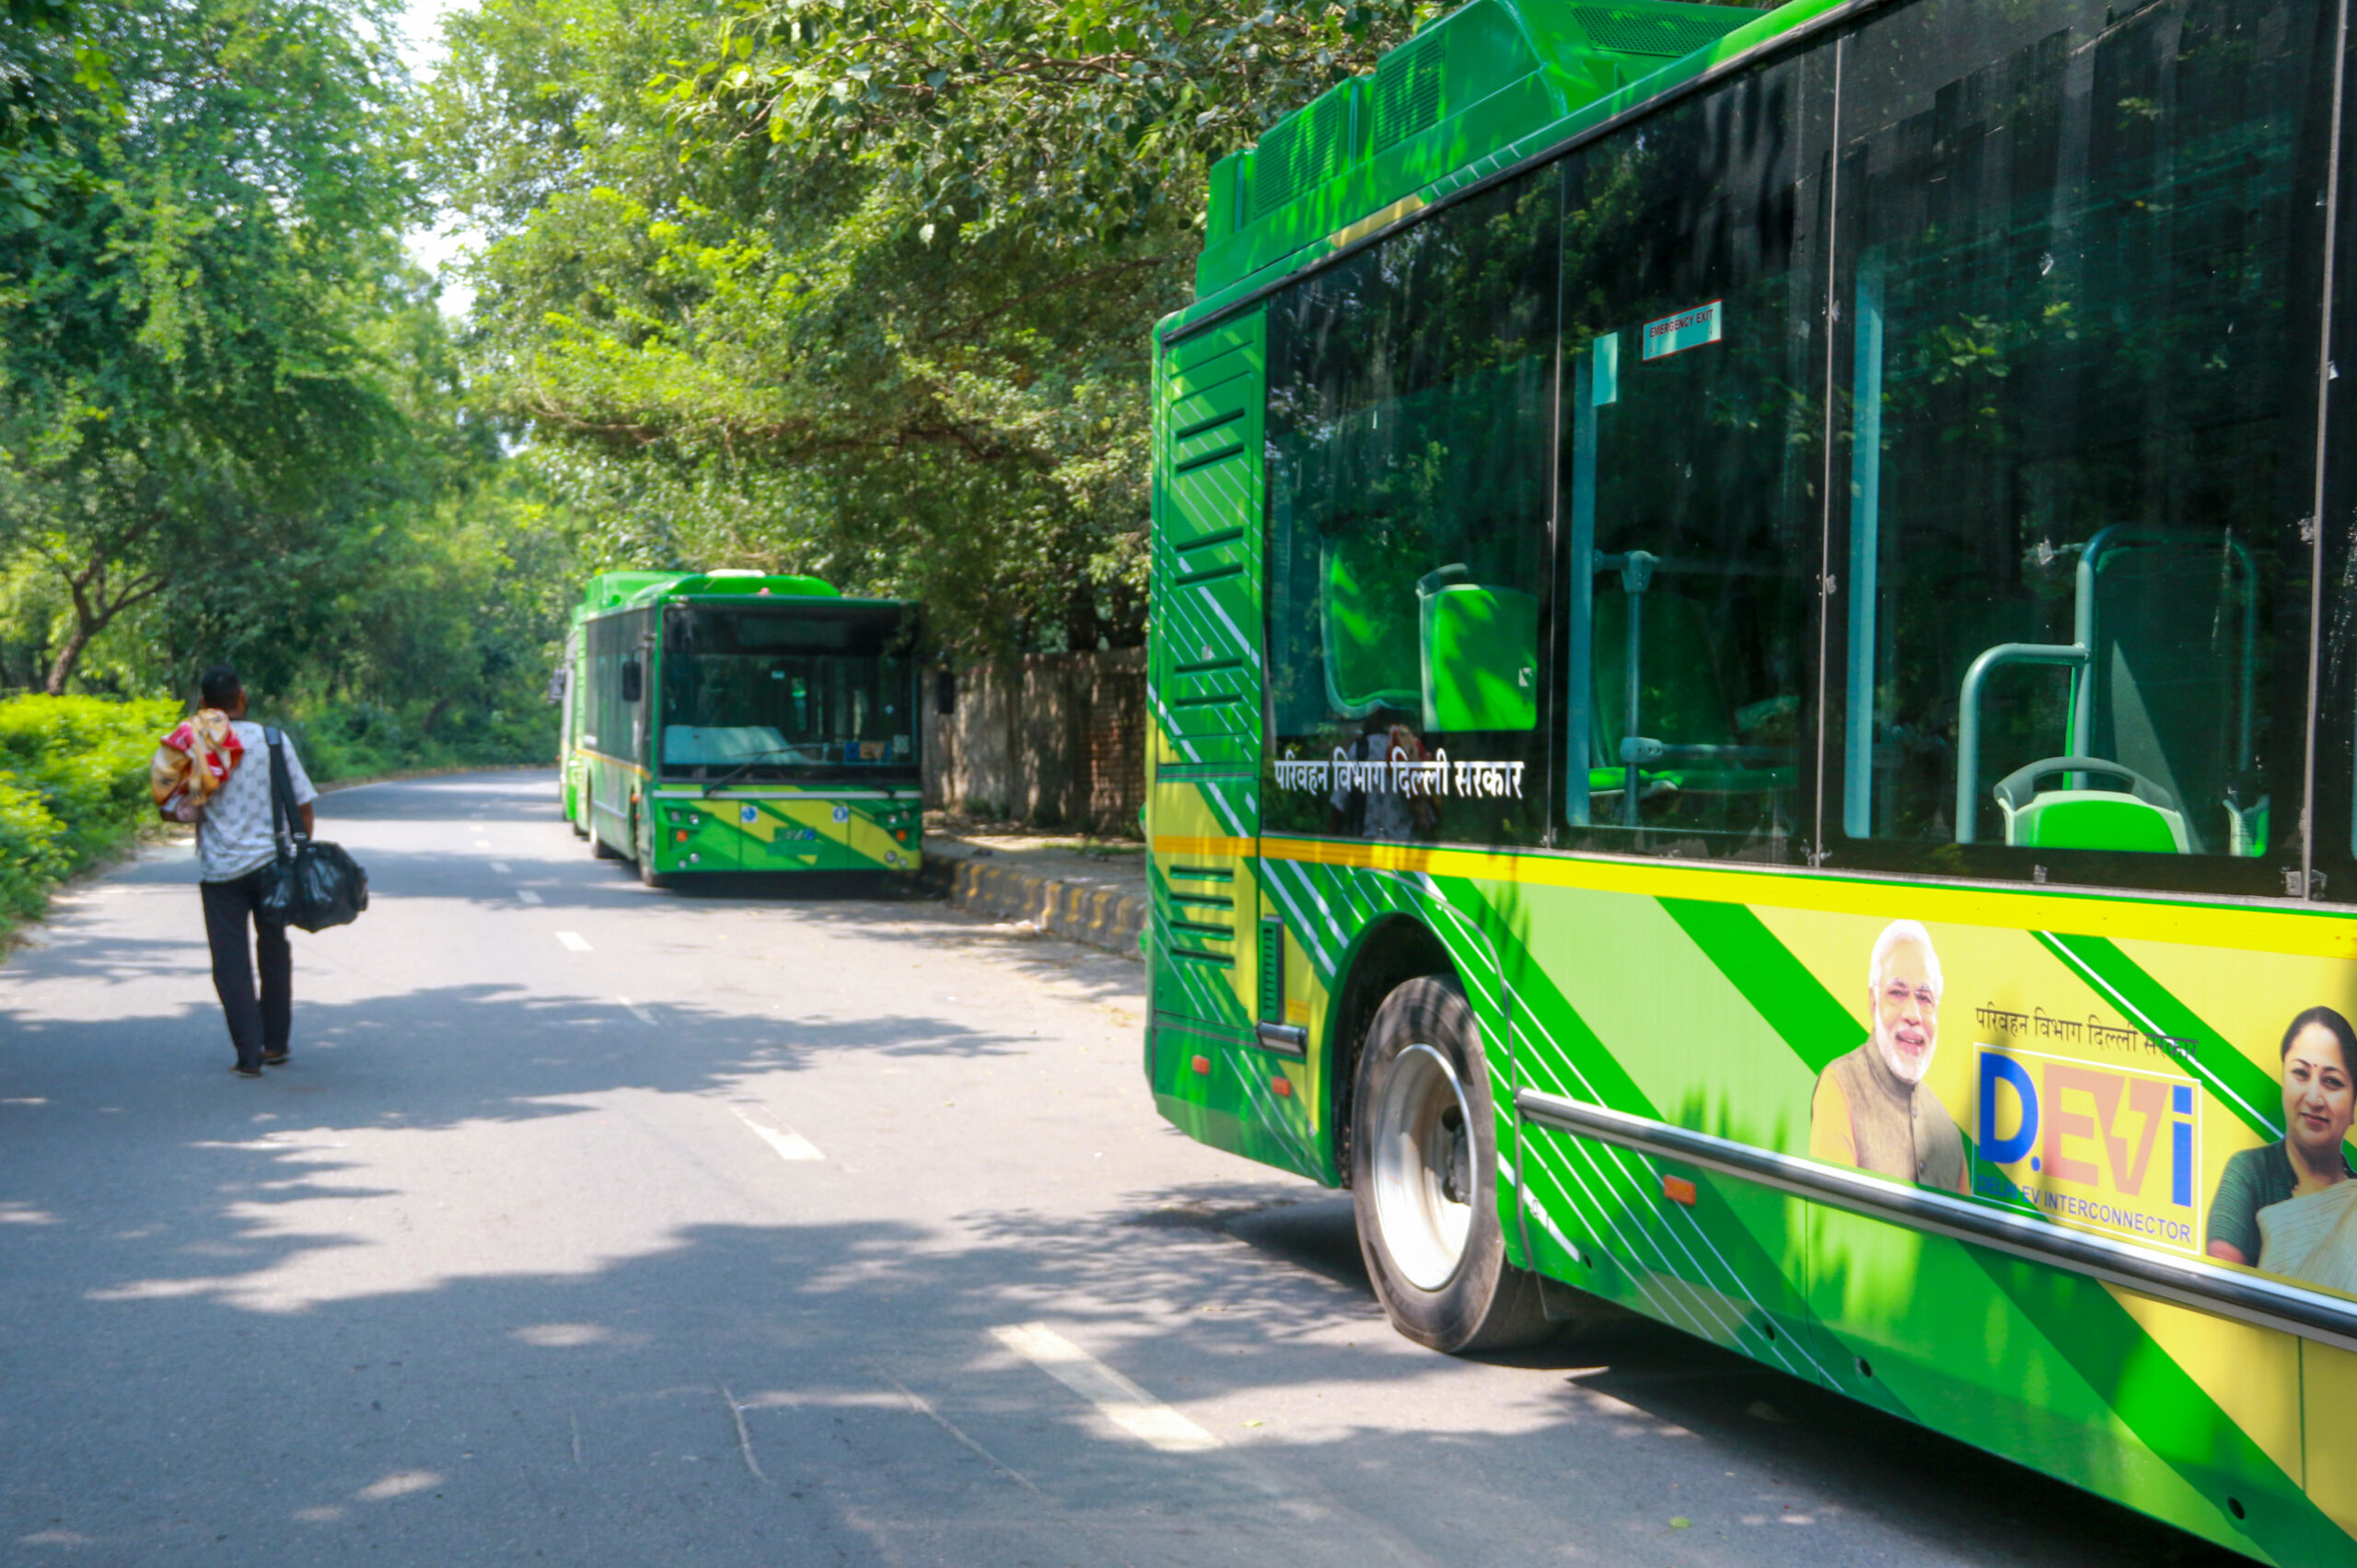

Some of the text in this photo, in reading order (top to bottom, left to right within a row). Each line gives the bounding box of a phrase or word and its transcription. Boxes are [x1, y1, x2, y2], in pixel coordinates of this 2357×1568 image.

[1650, 309, 1713, 337] EMERGENCY EXIT
[1273, 746, 1525, 799] परिवहन विभाग दिल्ली सरकार
[1976, 1001, 2199, 1060] परिवहन विभाग दिल्ली सरकार
[1977, 1174, 2191, 1244] DELHI EV INTERCONNECTOR
